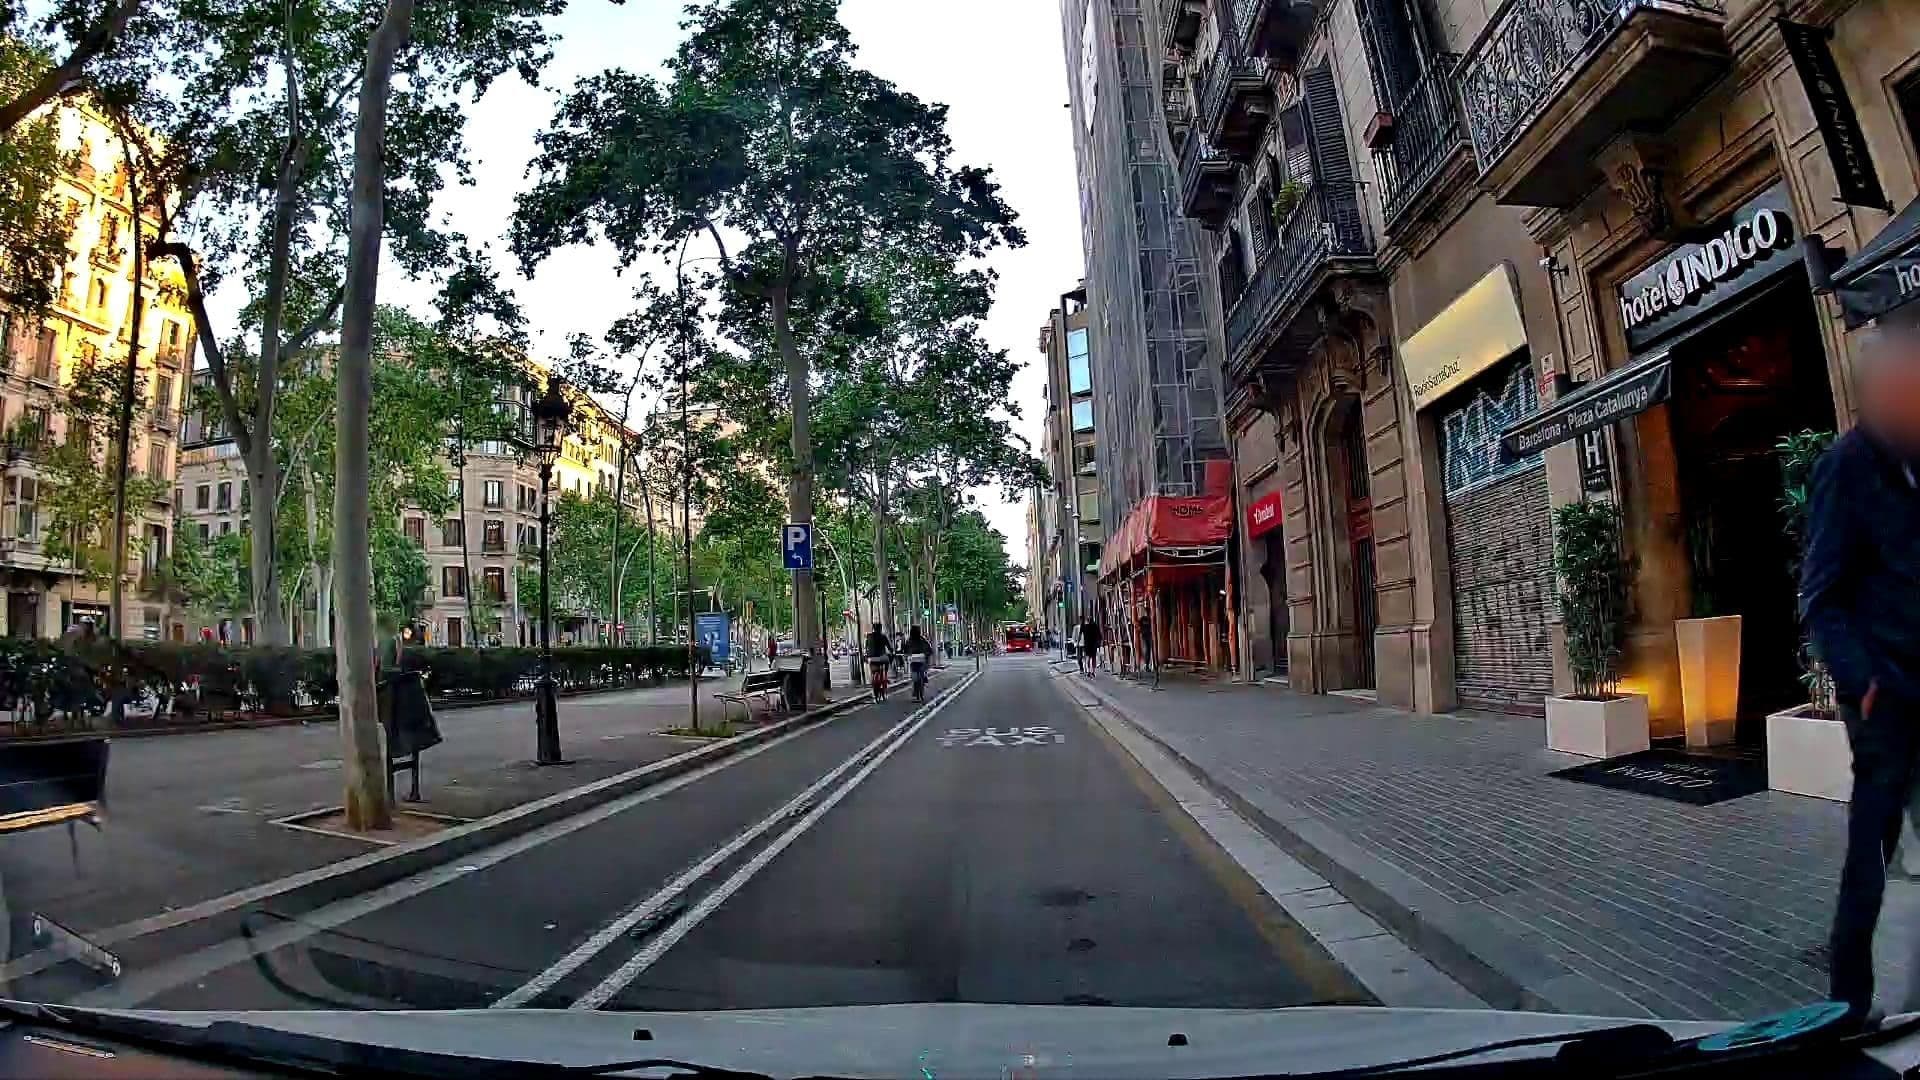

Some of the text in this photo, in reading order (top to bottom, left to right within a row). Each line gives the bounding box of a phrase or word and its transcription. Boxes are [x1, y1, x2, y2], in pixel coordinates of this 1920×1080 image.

[1619, 208, 1777, 329] hotel INDIGO
[1518, 423, 1561, 451] Barcelona
[1567, 409, 1594, 431] Plaza
[1594, 385, 1648, 419] Catalunya
[1584, 430, 1601, 468] H
[787, 526, 807, 550] P
[936, 735, 1065, 747] TAXI
